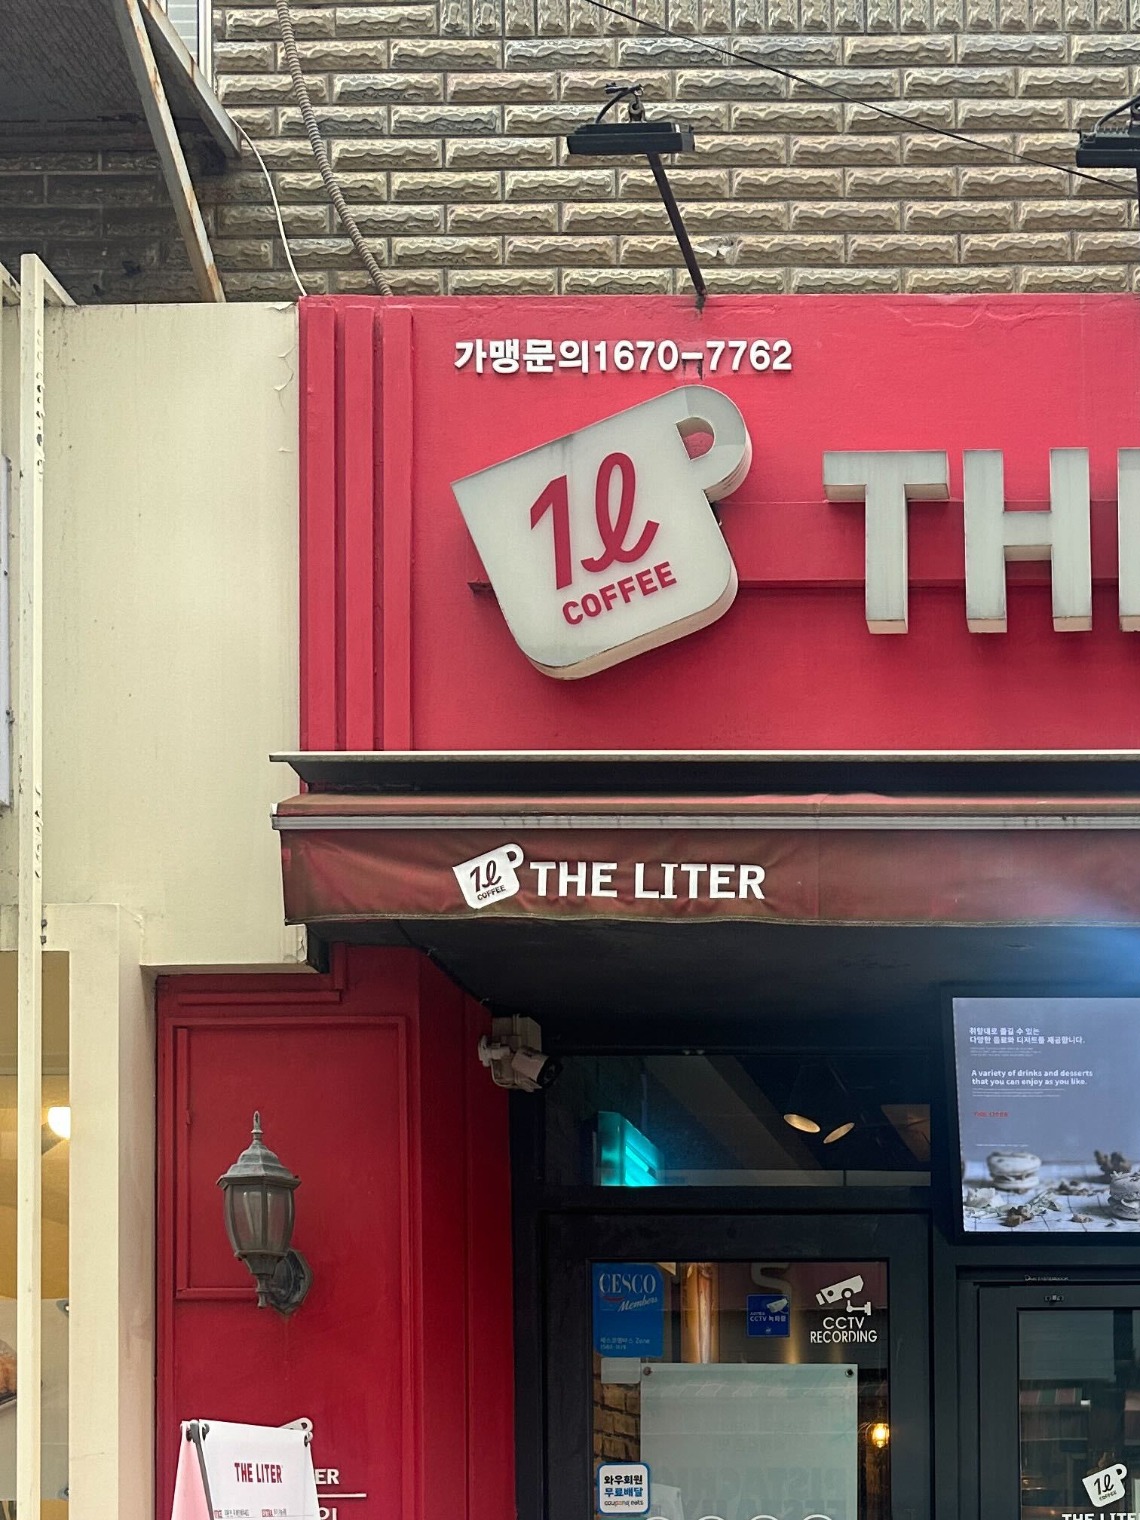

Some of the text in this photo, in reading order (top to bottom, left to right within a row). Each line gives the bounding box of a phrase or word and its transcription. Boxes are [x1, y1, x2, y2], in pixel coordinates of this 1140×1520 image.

[560, 560, 677, 626] COFFEE
[529, 861, 765, 900] THE LITER
[477, 885, 507, 901] COFFEE
[978, 1070, 1006, 1078] variety
[1021, 1078, 1043, 1086] enjoy
[599, 1273, 657, 1294] CESCO
[617, 1295, 658, 1312] Members
[823, 1316, 865, 1329] CCTV
[810, 1330, 878, 1343] RECORDING
[234, 1462, 283, 1483] THE LITER
[604, 1475, 643, 1485] 와우회원
[604, 1487, 643, 1497] 무료배달
